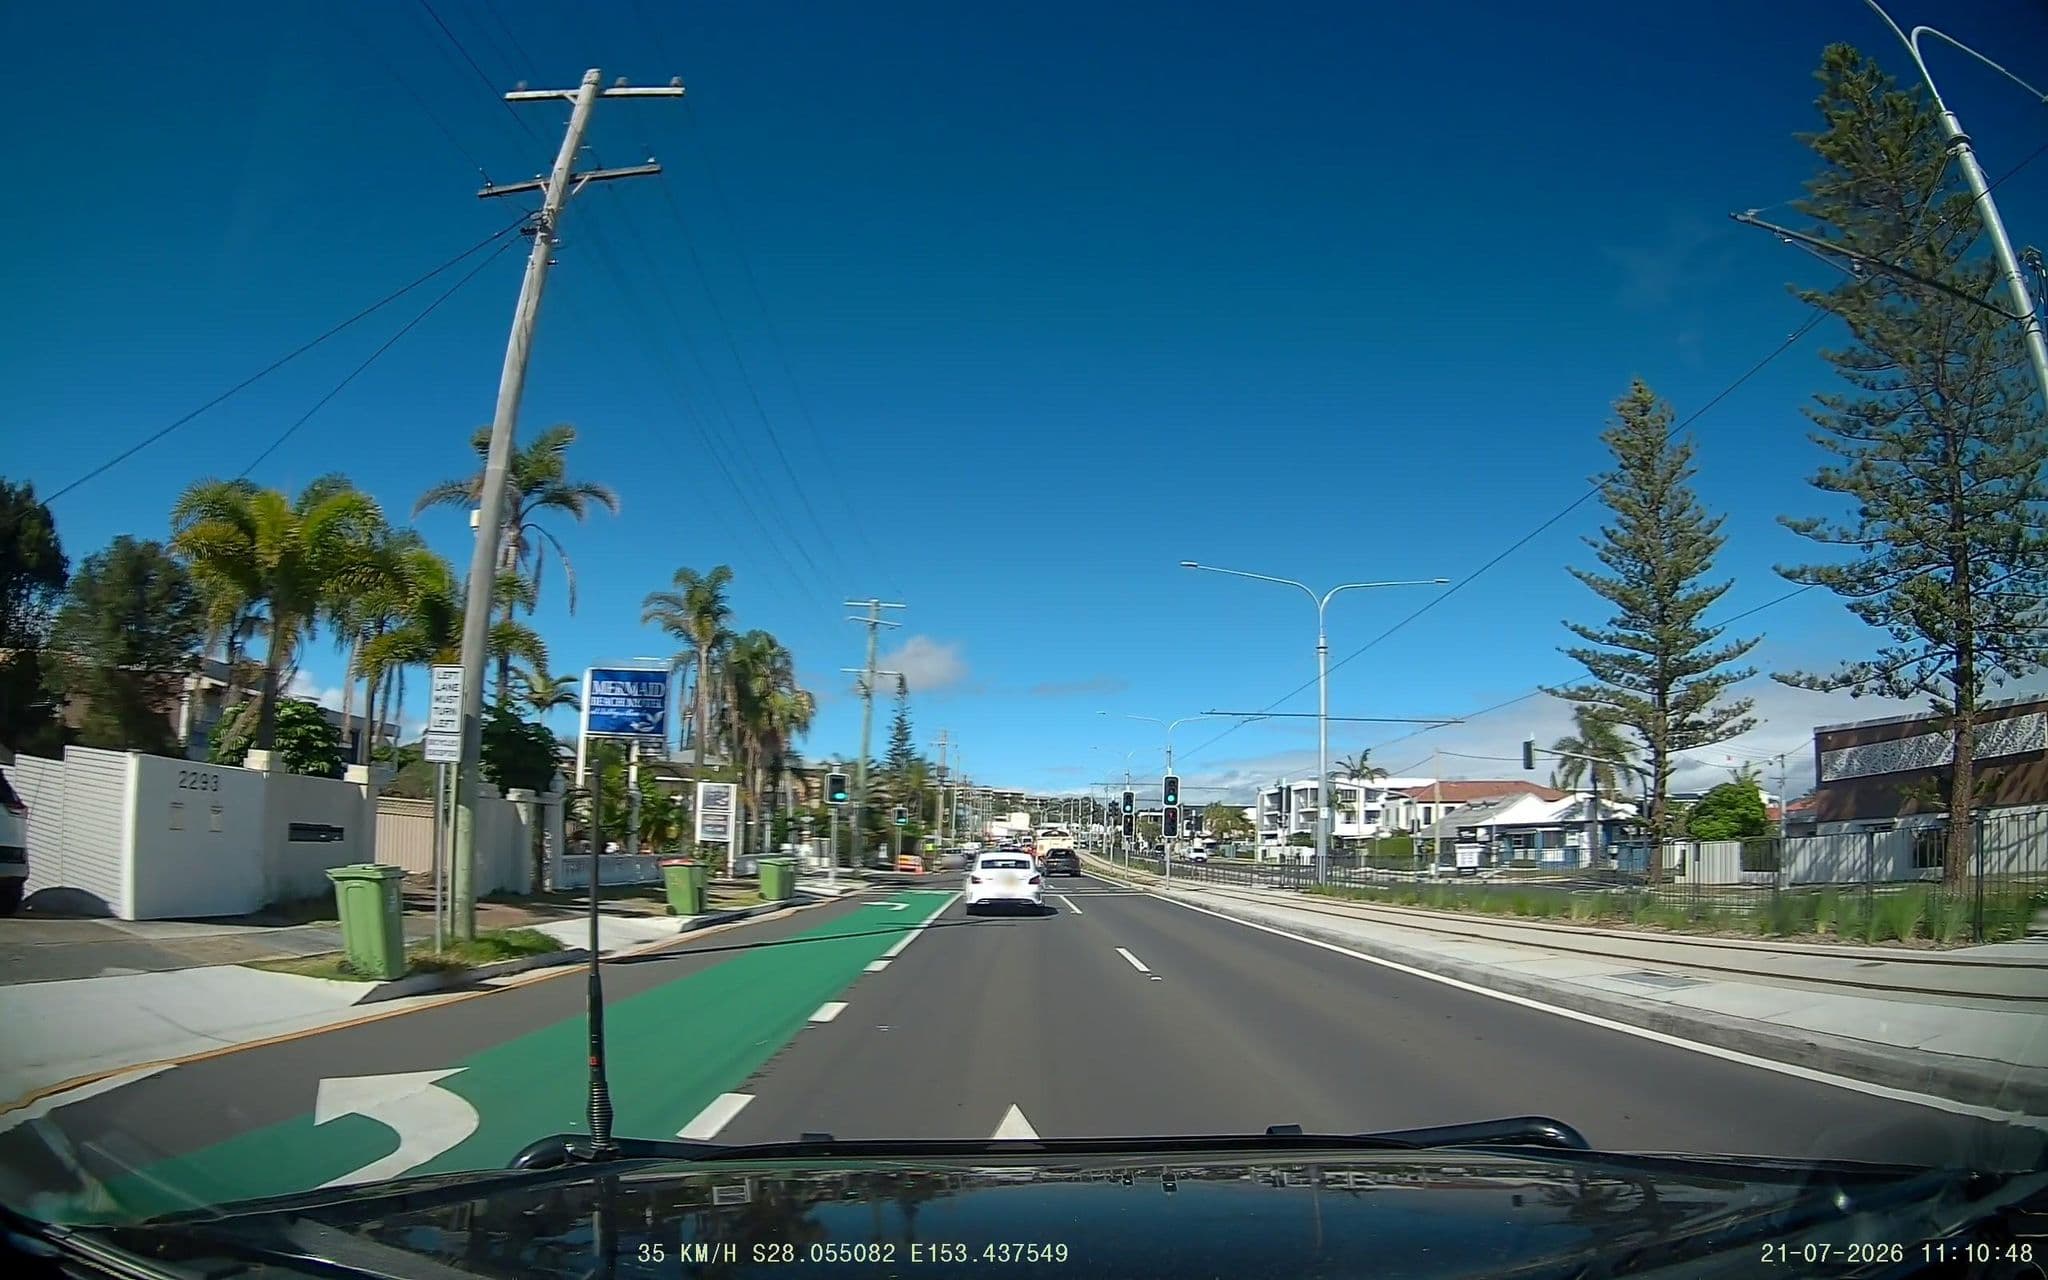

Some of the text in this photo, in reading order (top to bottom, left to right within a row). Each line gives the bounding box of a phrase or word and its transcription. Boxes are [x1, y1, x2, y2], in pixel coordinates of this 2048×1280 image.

[437, 671, 460, 680] LEFT
[435, 683, 460, 692] LANE
[591, 681, 666, 697] MERMAID
[434, 695, 460, 704] MUST
[432, 707, 458, 716] TURN
[432, 719, 456, 728] LEFT
